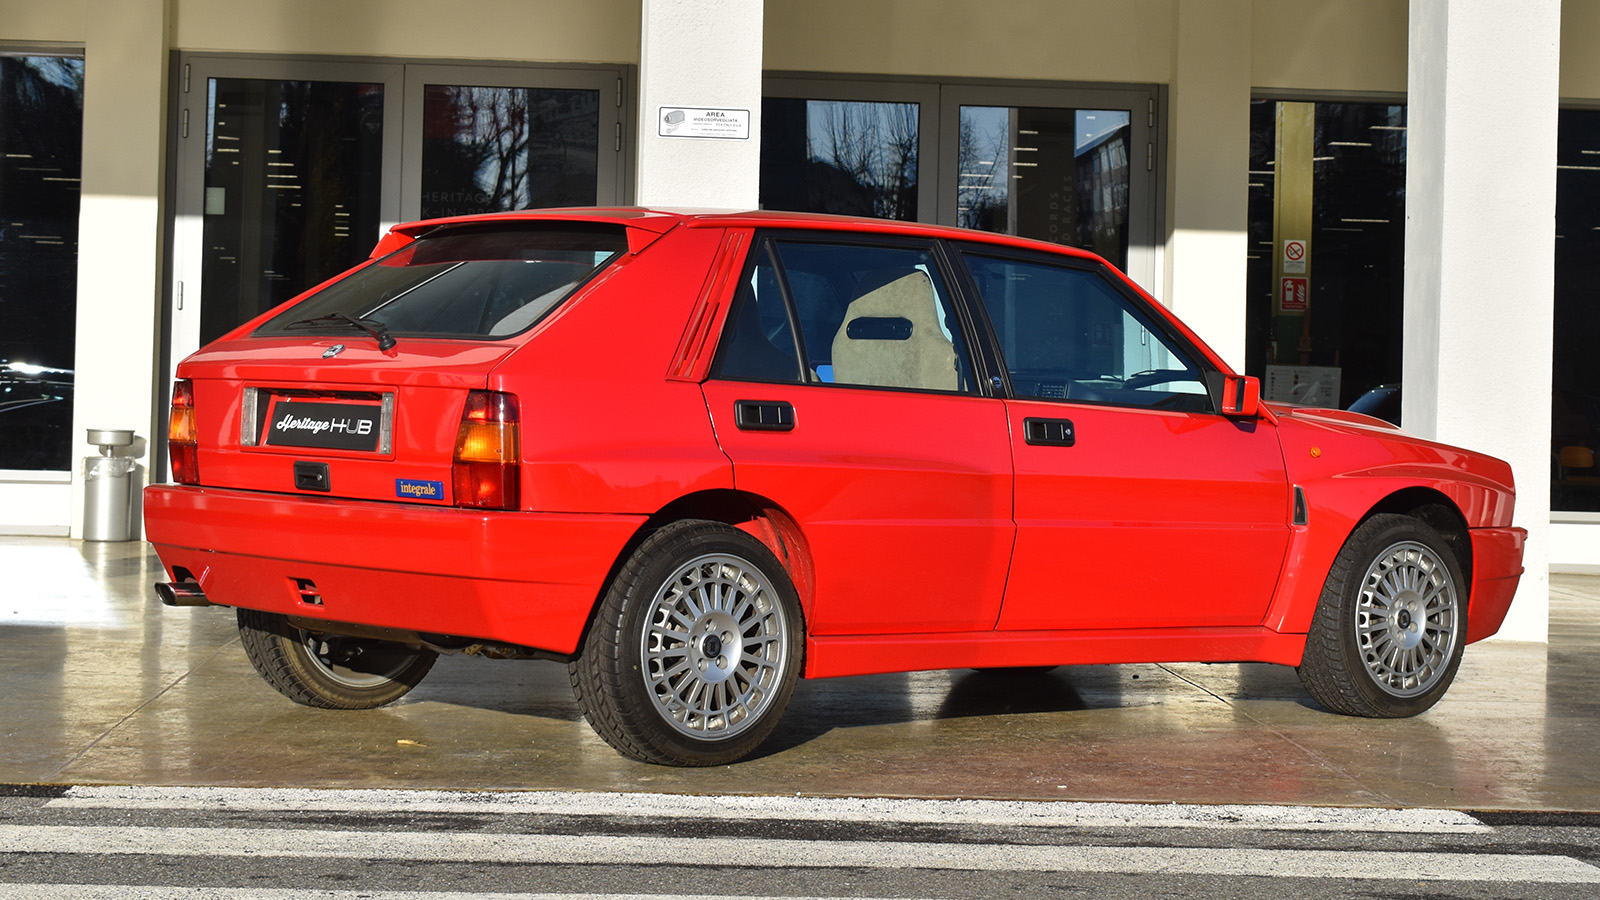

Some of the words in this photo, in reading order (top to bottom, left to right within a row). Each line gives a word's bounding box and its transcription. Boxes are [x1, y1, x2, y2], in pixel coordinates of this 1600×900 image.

[1062, 175, 1072, 224] RACES
[276, 413, 330, 434] Heritage
[330, 417, 373, 435] HUB
[400, 481, 436, 497] integrale
